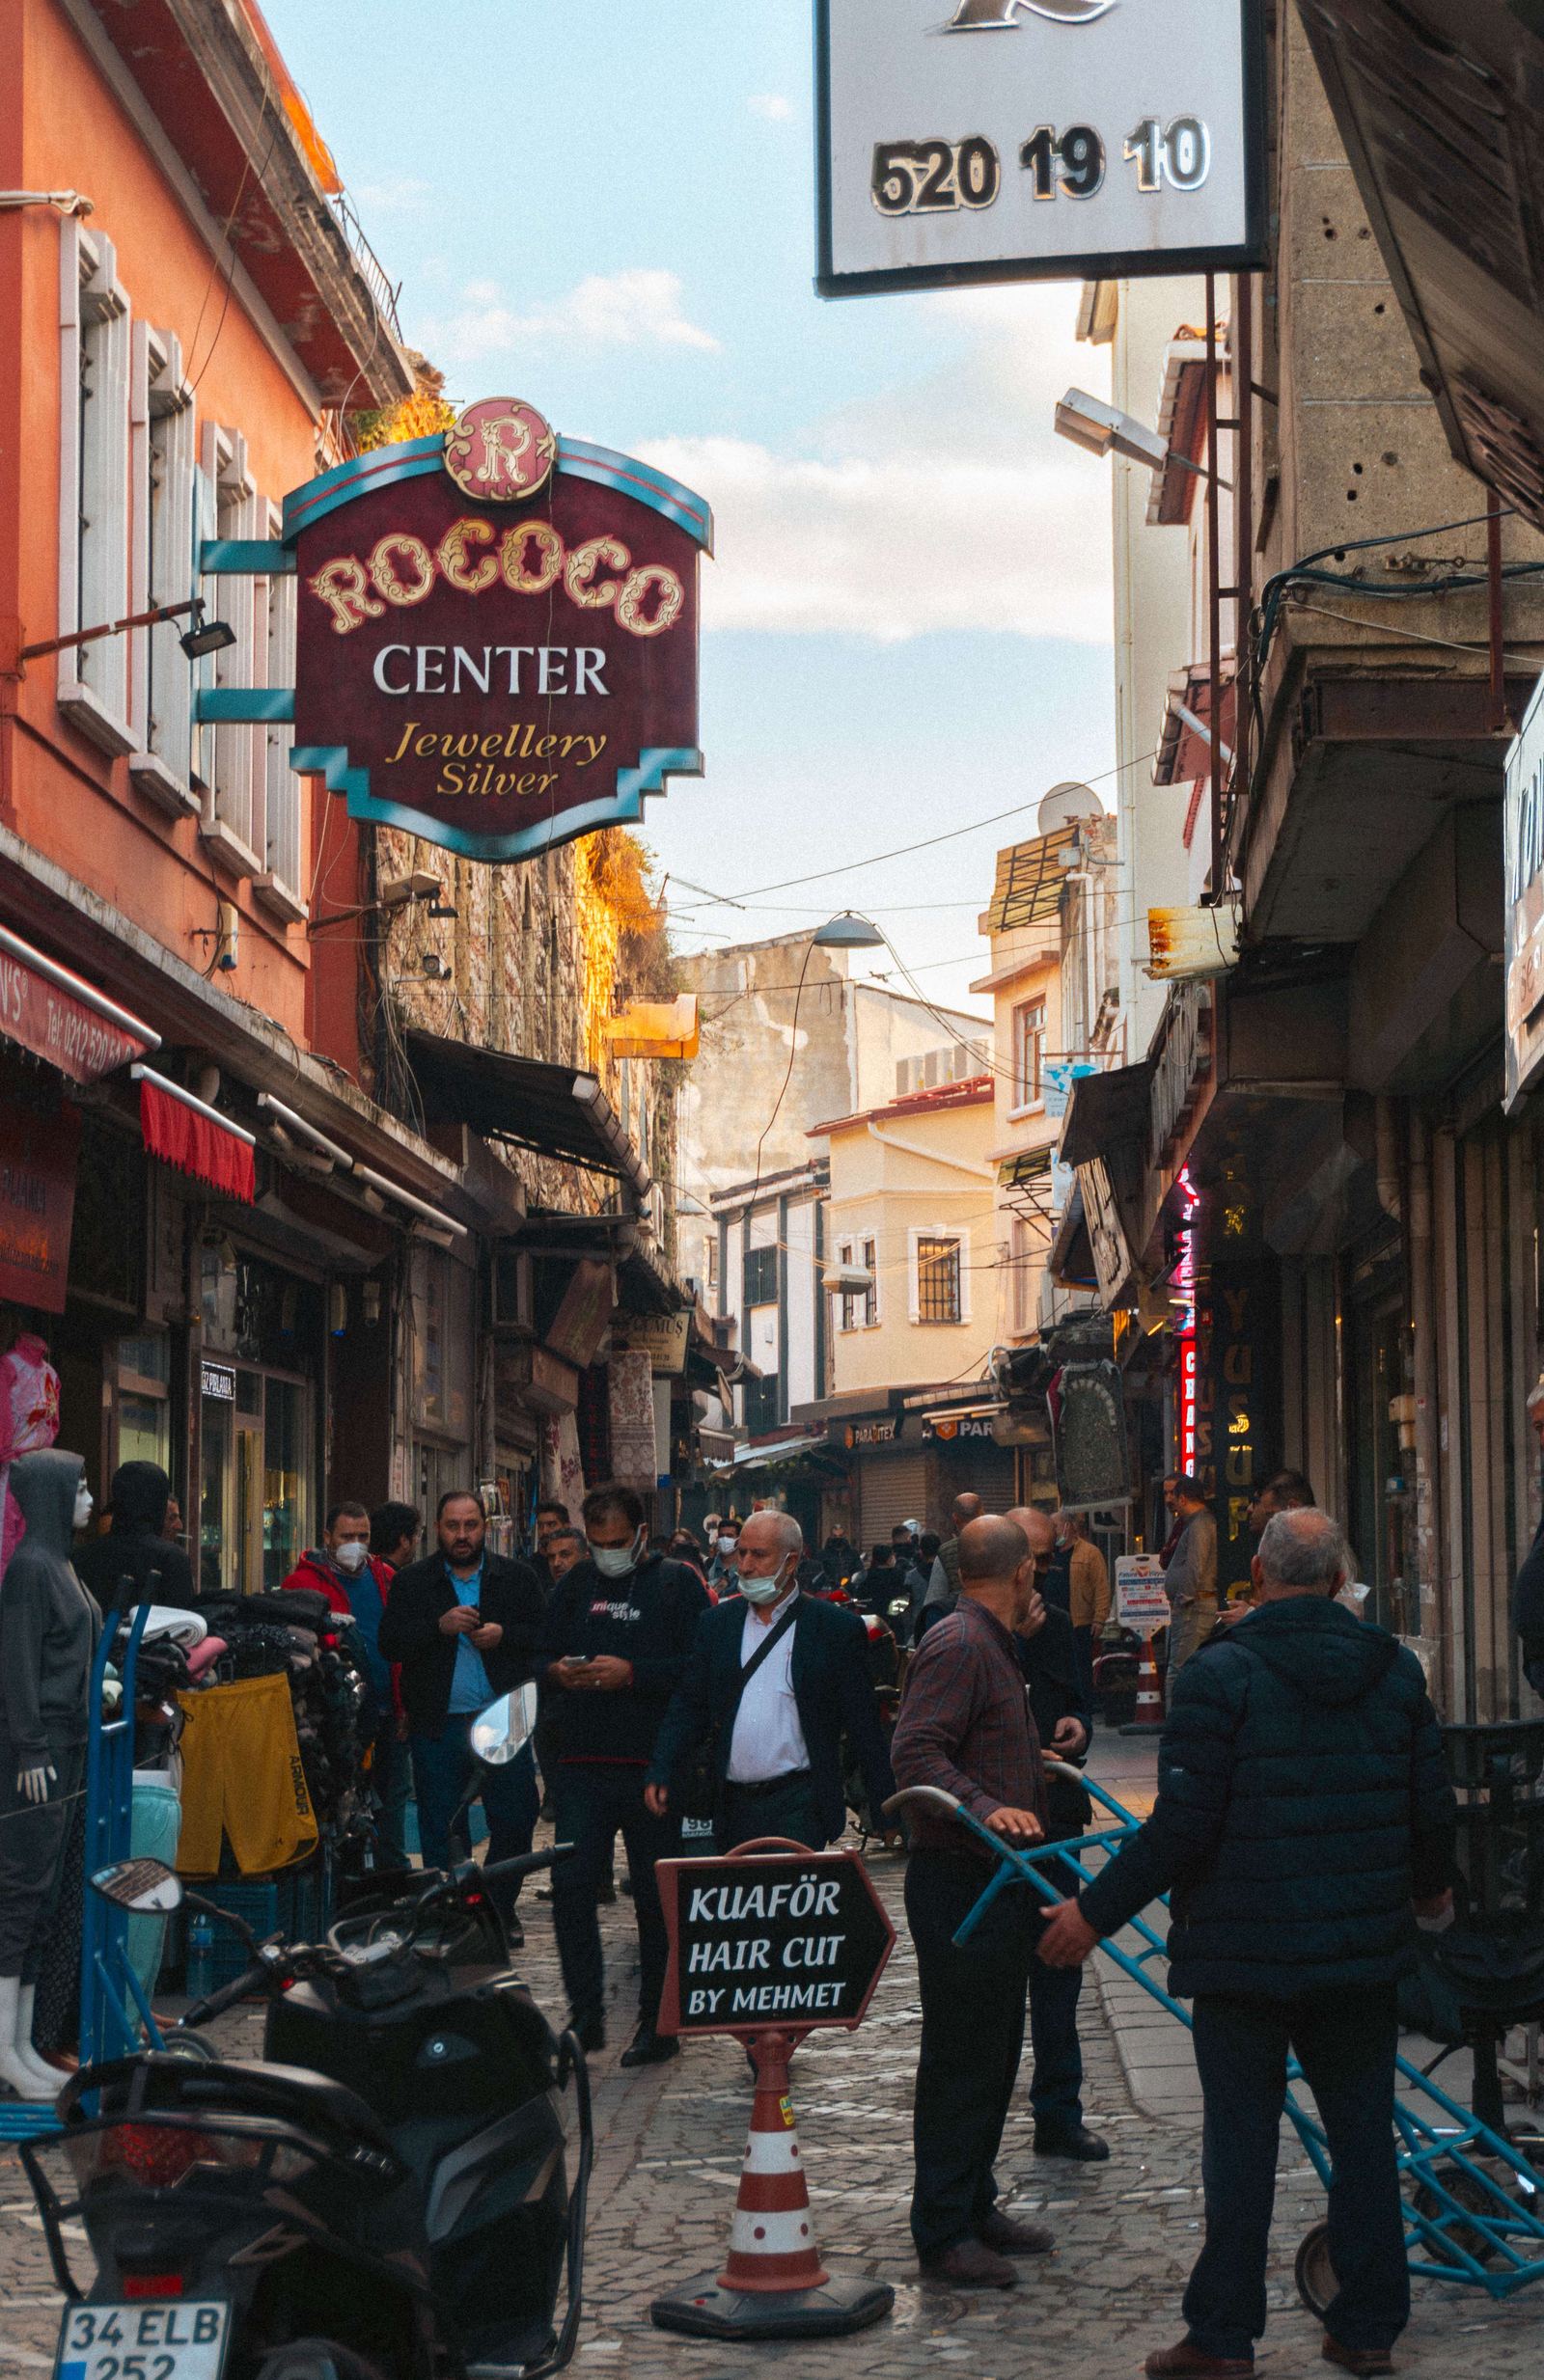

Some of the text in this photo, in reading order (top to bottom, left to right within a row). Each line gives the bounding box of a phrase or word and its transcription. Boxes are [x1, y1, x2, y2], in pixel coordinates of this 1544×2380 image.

[870, 114, 1210, 216] 520 19 10
[480, 416, 532, 483] R
[310, 518, 684, 636] ROCOCO
[372, 644, 610, 696] CENTER
[385, 723, 606, 765] Jewellery
[437, 763, 559, 796] Silver
[47, 999, 63, 1048] Tel:
[64, 1011, 88, 1062] 0212
[959, 1421, 993, 1436] PAR
[688, 1874, 841, 1923] KUAFÖR
[688, 1934, 846, 1973] HAIR CUT
[688, 1982, 846, 2015] BY MEHMET
[70, 2308, 220, 2351] 34 ELB
[96, 2354, 176, 2380] 252
